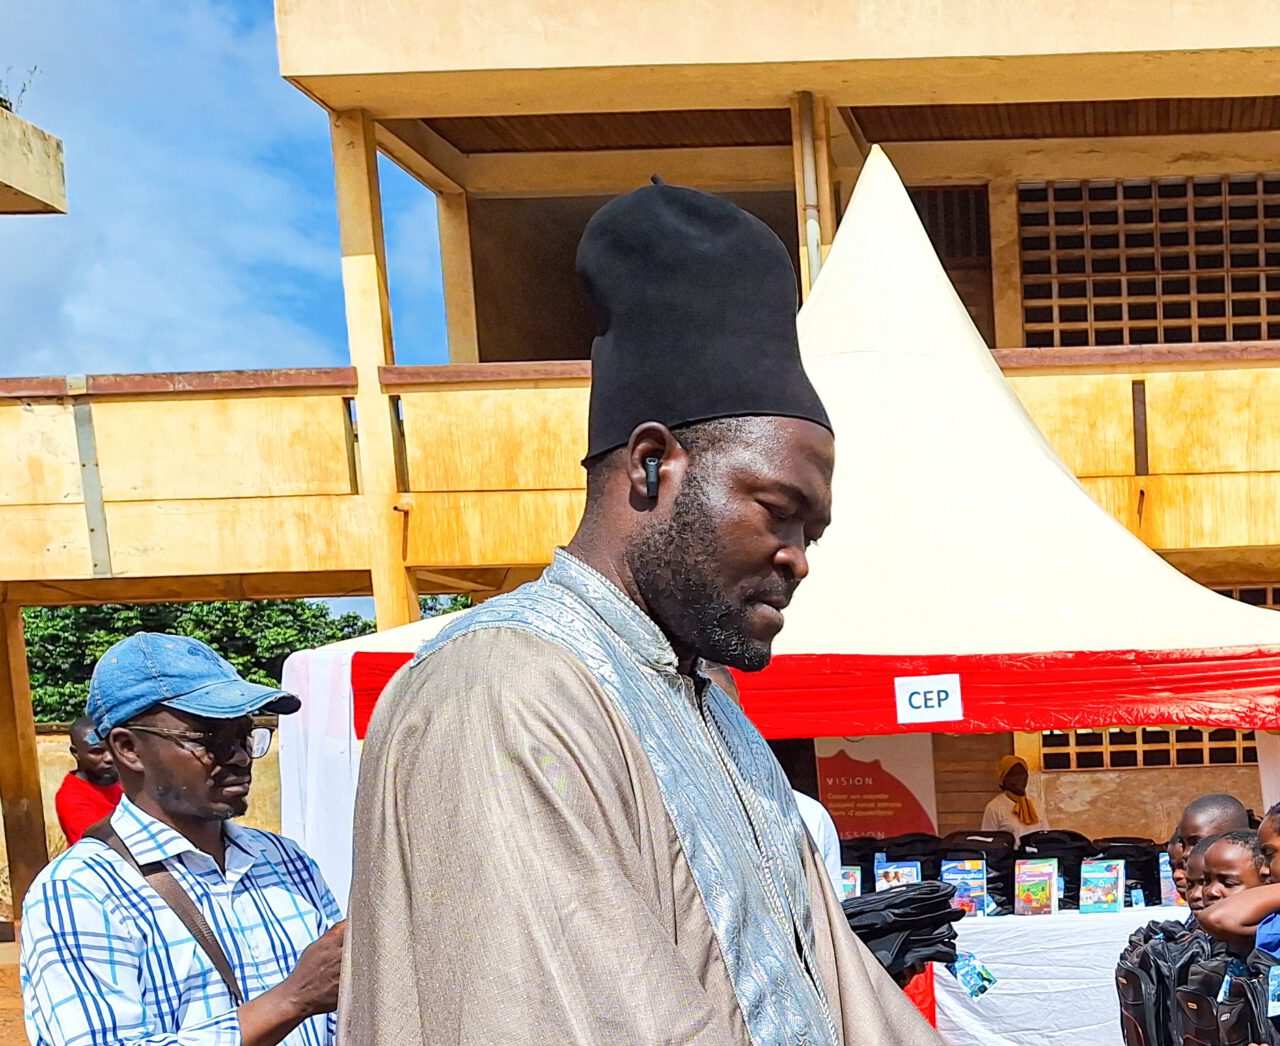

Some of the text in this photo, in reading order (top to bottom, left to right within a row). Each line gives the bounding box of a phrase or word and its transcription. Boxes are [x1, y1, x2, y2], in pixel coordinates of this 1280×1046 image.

[908, 689, 950, 709] CEP
[826, 777, 873, 786] VISION
[840, 831, 886, 839] ISSION
